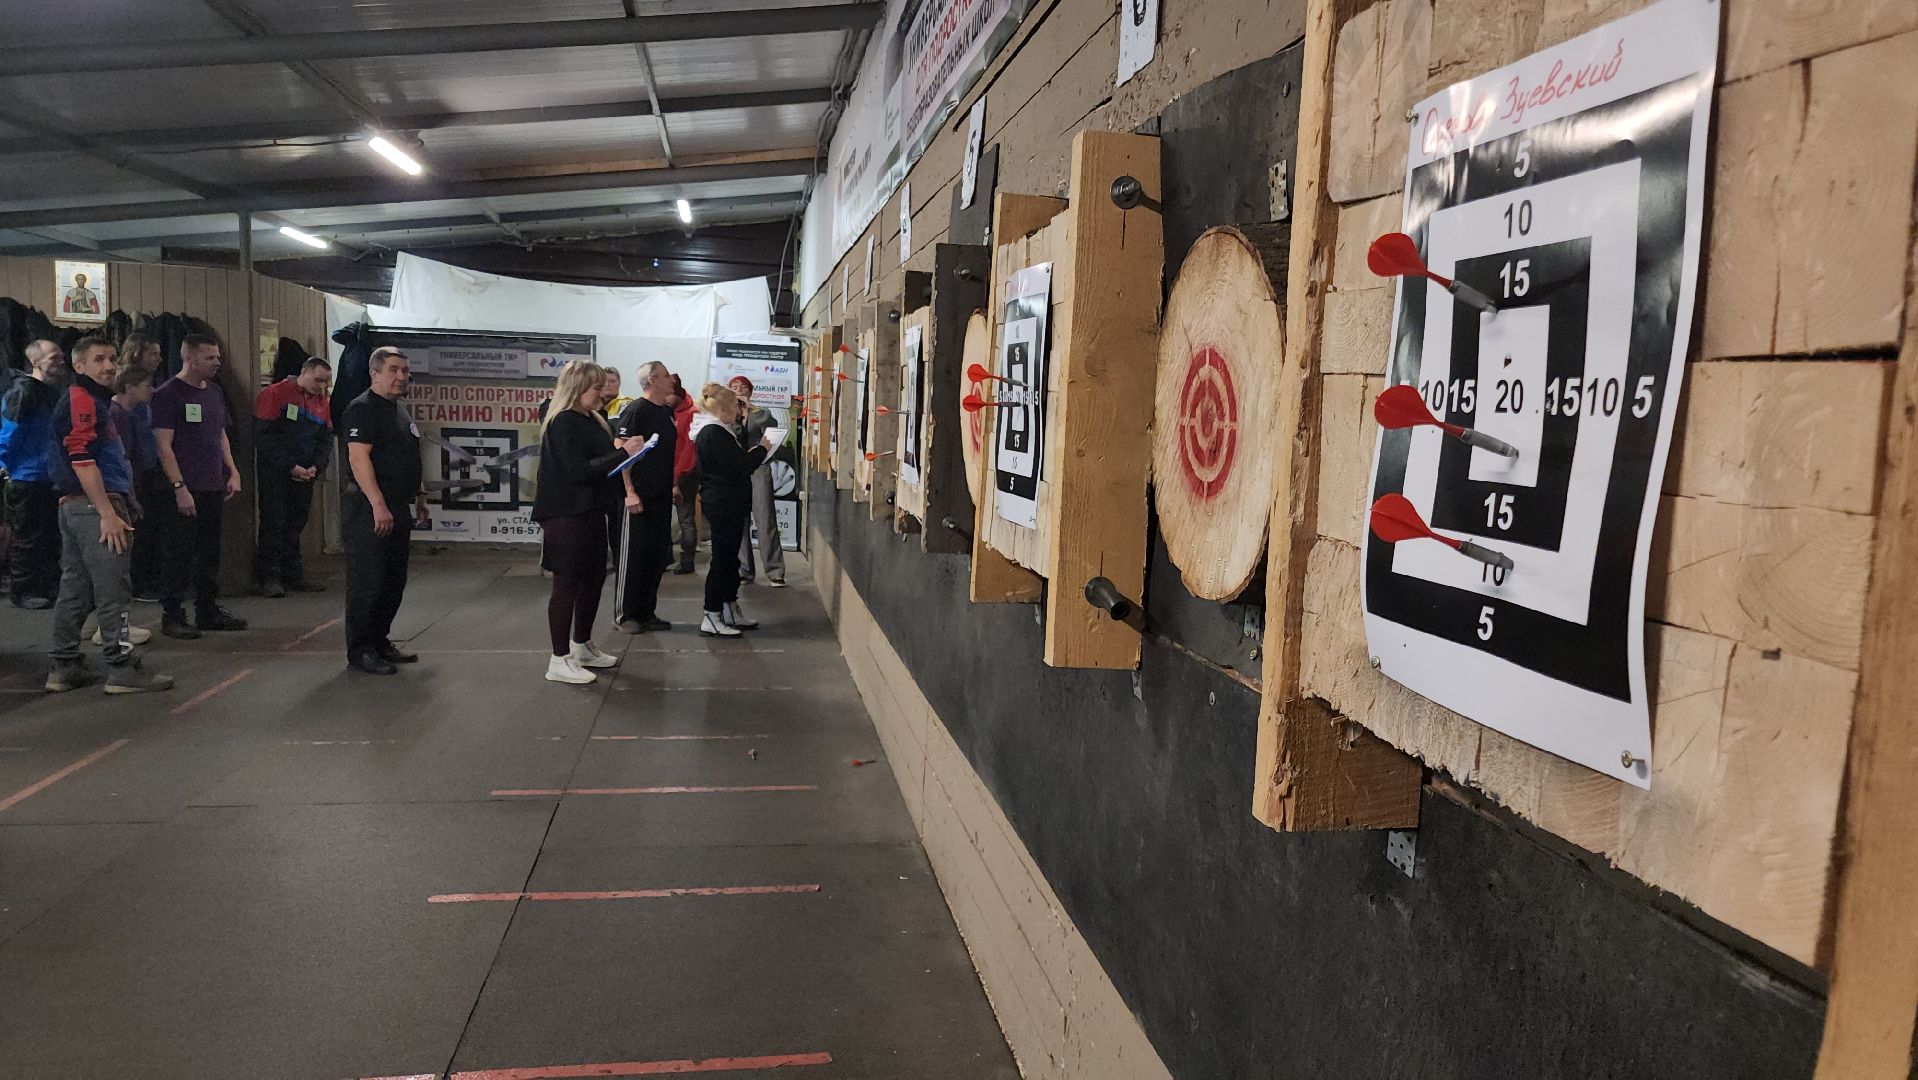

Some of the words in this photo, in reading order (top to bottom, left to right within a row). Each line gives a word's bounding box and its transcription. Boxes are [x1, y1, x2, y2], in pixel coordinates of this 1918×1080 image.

[1513, 139, 1532, 178] 5
[1503, 199, 1533, 239] 10
[1499, 258, 1531, 299] 15
[440, 386, 460, 401] ПО
[465, 387, 553, 404] СПОРТИВНО
[1034, 390, 1039, 406] 5
[1420, 378, 1445, 412] 10
[1448, 376, 1477, 415] 15
[1494, 379, 1524, 415] 20
[1546, 376, 1582, 418] 15
[1586, 376, 1620, 418] 10
[1631, 375, 1655, 419] 5
[501, 406, 540, 424] НОЖ
[350, 428, 359, 437] Z
[619, 427, 628, 435] Z
[1013, 433, 1021, 449] 15
[1009, 476, 1015, 491] 5
[1483, 491, 1515, 531] 15
[490, 526, 541, 535] 8-916-57
[1476, 605, 1496, 641] 5
